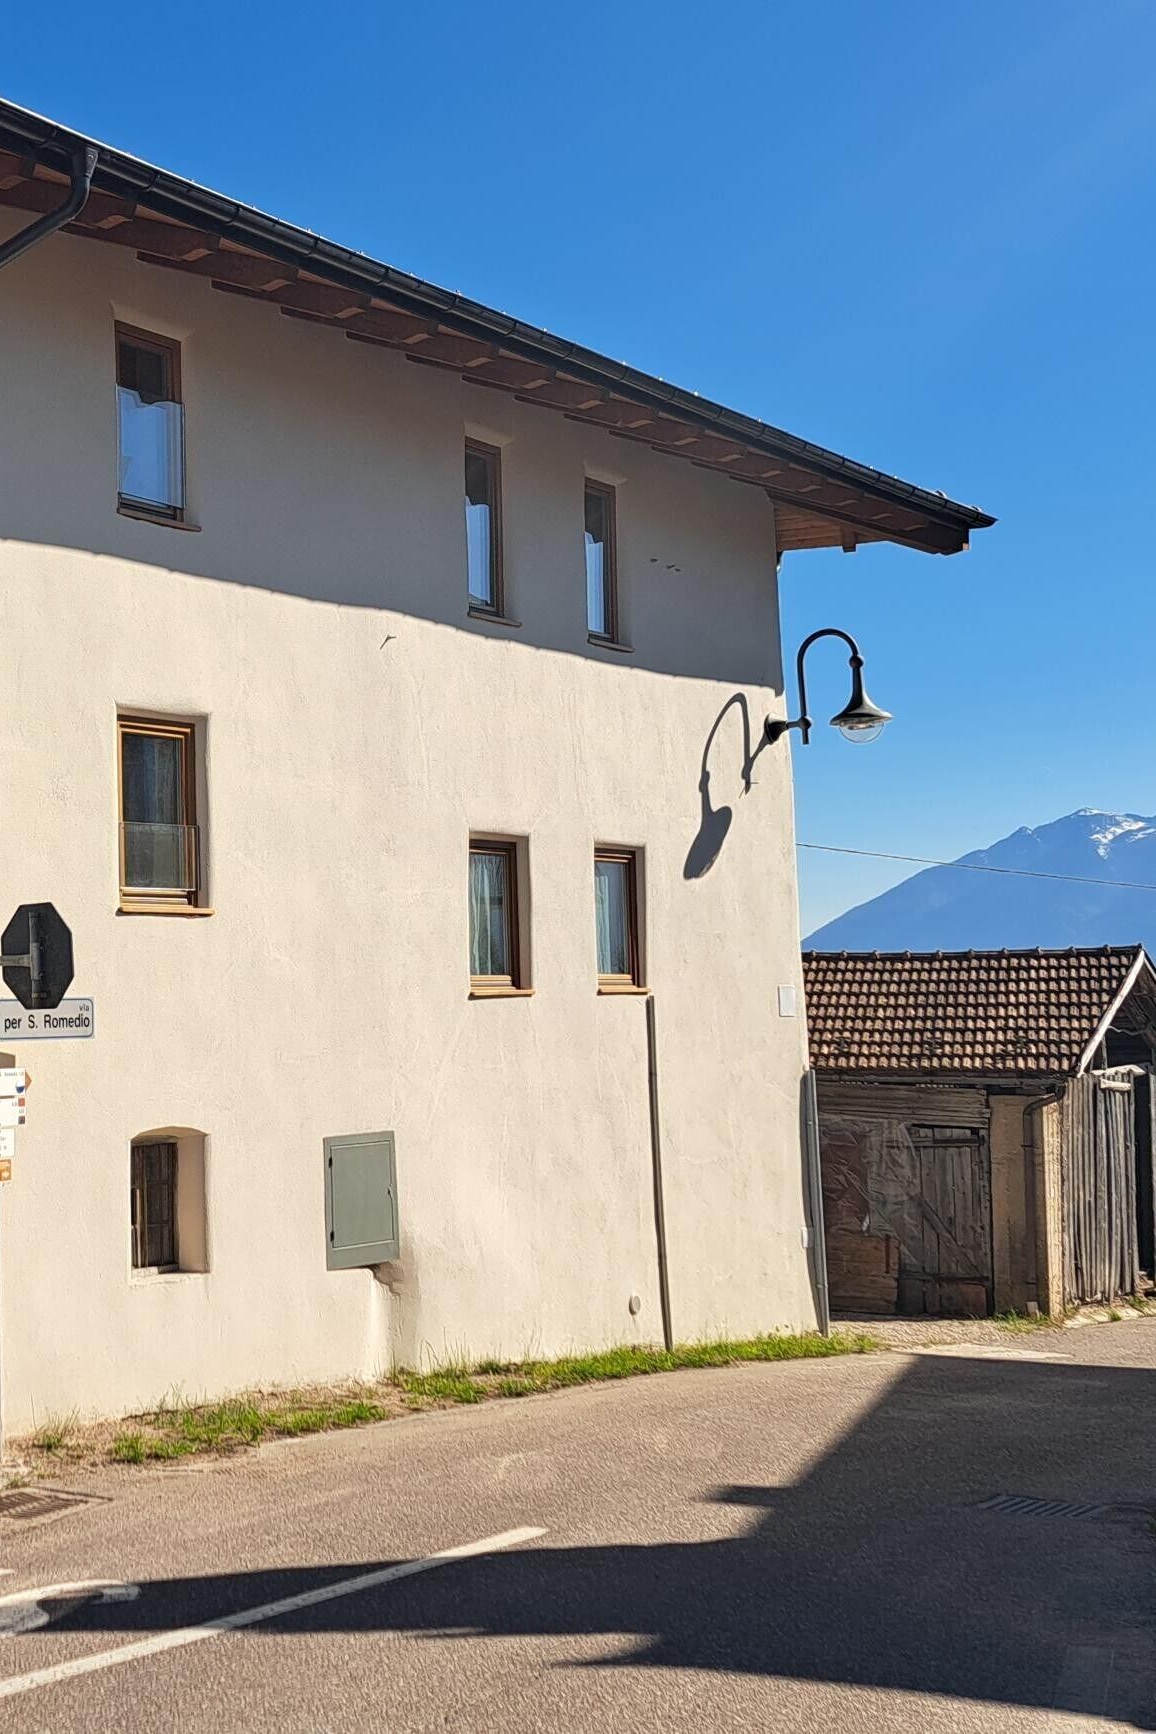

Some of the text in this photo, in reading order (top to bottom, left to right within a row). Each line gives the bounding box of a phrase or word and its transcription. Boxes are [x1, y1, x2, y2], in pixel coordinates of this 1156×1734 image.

[79, 1003, 90, 1012] via
[4, 1013, 90, 1032] per S. Romedio
